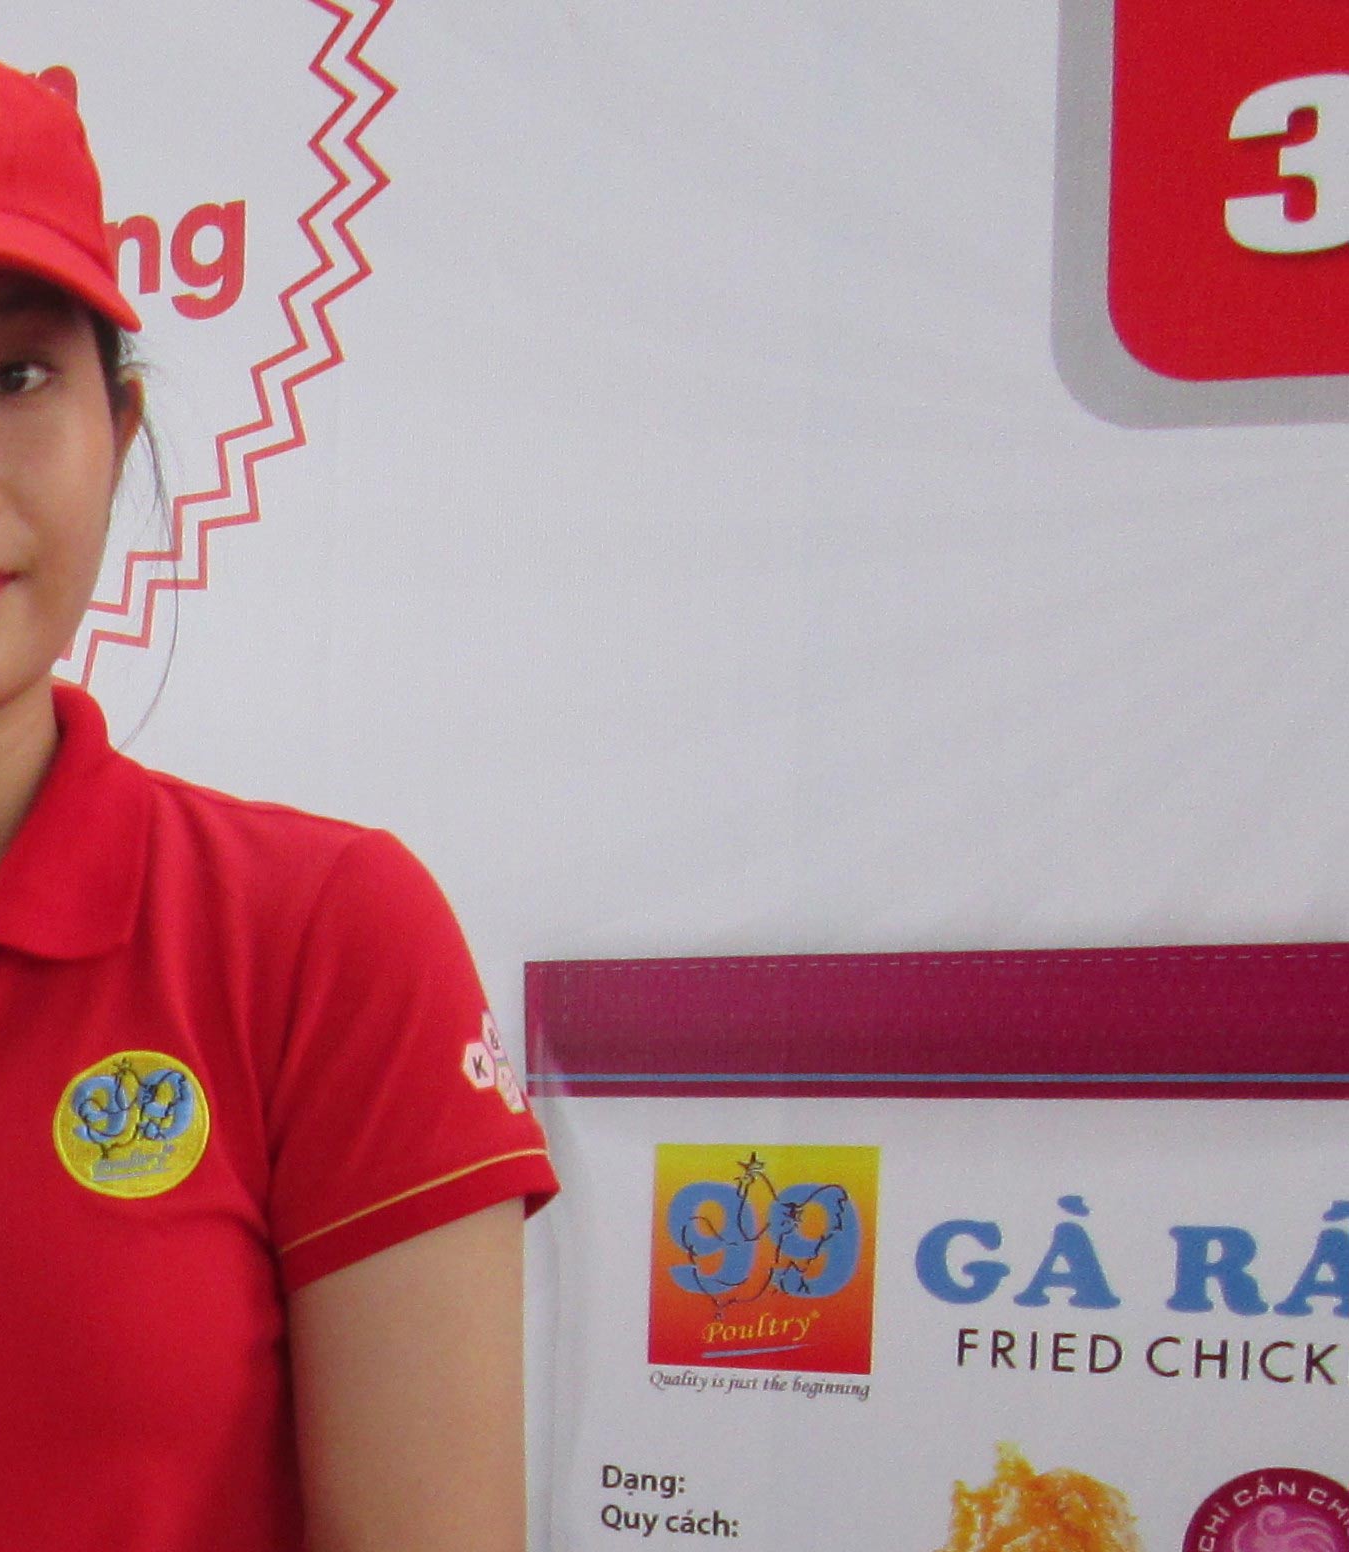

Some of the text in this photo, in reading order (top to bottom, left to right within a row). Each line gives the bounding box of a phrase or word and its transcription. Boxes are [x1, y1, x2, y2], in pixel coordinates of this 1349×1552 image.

[71, 1067, 195, 1142] 99
[666, 1180, 861, 1300] 99
[915, 1194, 1122, 1310] GÀ
[705, 1310, 816, 1344] Poultry
[957, 1327, 1340, 1386] FRIED CHICK
[649, 1369, 871, 1399] Quality is just the beginning
[602, 1464, 686, 1499] Dạng:
[600, 1503, 740, 1538] Quy cách:
